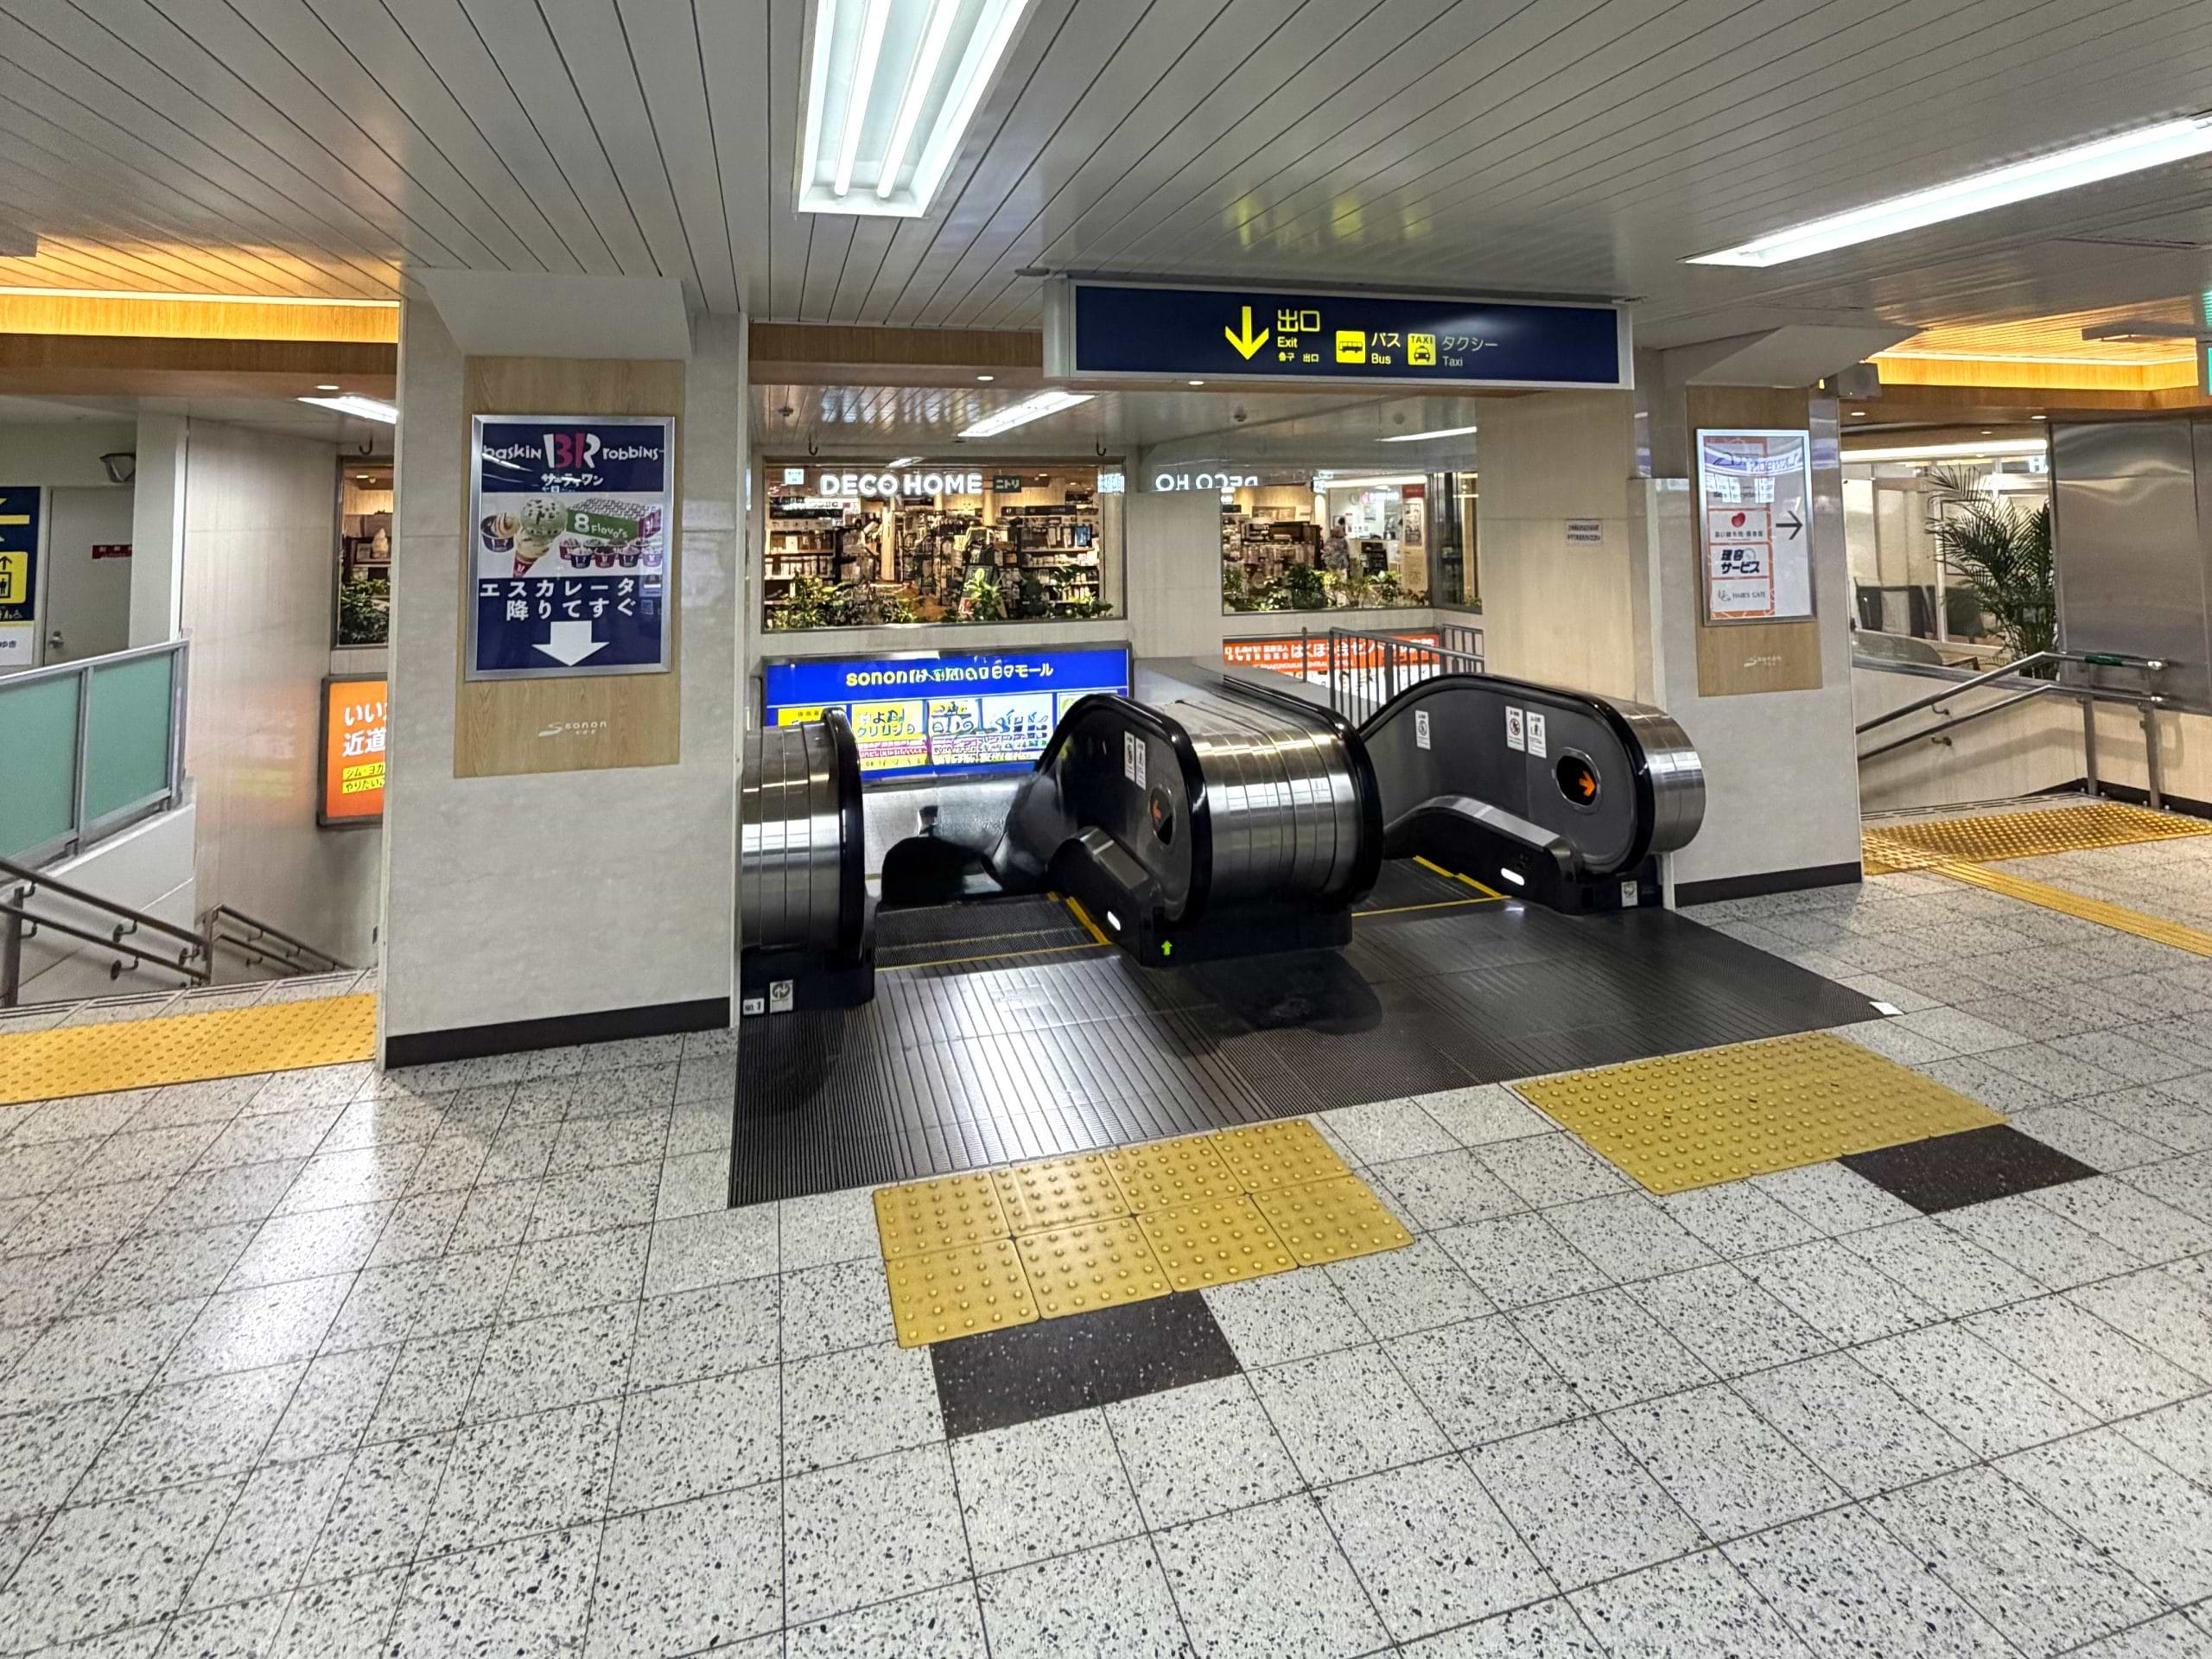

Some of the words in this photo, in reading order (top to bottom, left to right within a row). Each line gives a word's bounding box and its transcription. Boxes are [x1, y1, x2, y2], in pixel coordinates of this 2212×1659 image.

[1277, 308, 1320, 332] 出口
[1277, 336, 1298, 348] Exit
[1370, 332, 1401, 348] バス
[1410, 335, 1433, 344] TAXI
[1442, 335, 1498, 352] タクシー
[1371, 353, 1391, 365] Bus
[1442, 356, 1463, 366] Taxi
[603, 445, 659, 461] robbins
[821, 474, 899, 496] DECO
[903, 473, 983, 496] HOME
[995, 478, 1020, 490] ニトリ
[574, 512, 589, 533] 8
[591, 523, 628, 539] Flavors
[1721, 561, 1760, 575] サービス
[480, 577, 662, 598] エスカレーター
[505, 597, 636, 621] 降りてすぐ
[345, 702, 387, 727] いい
